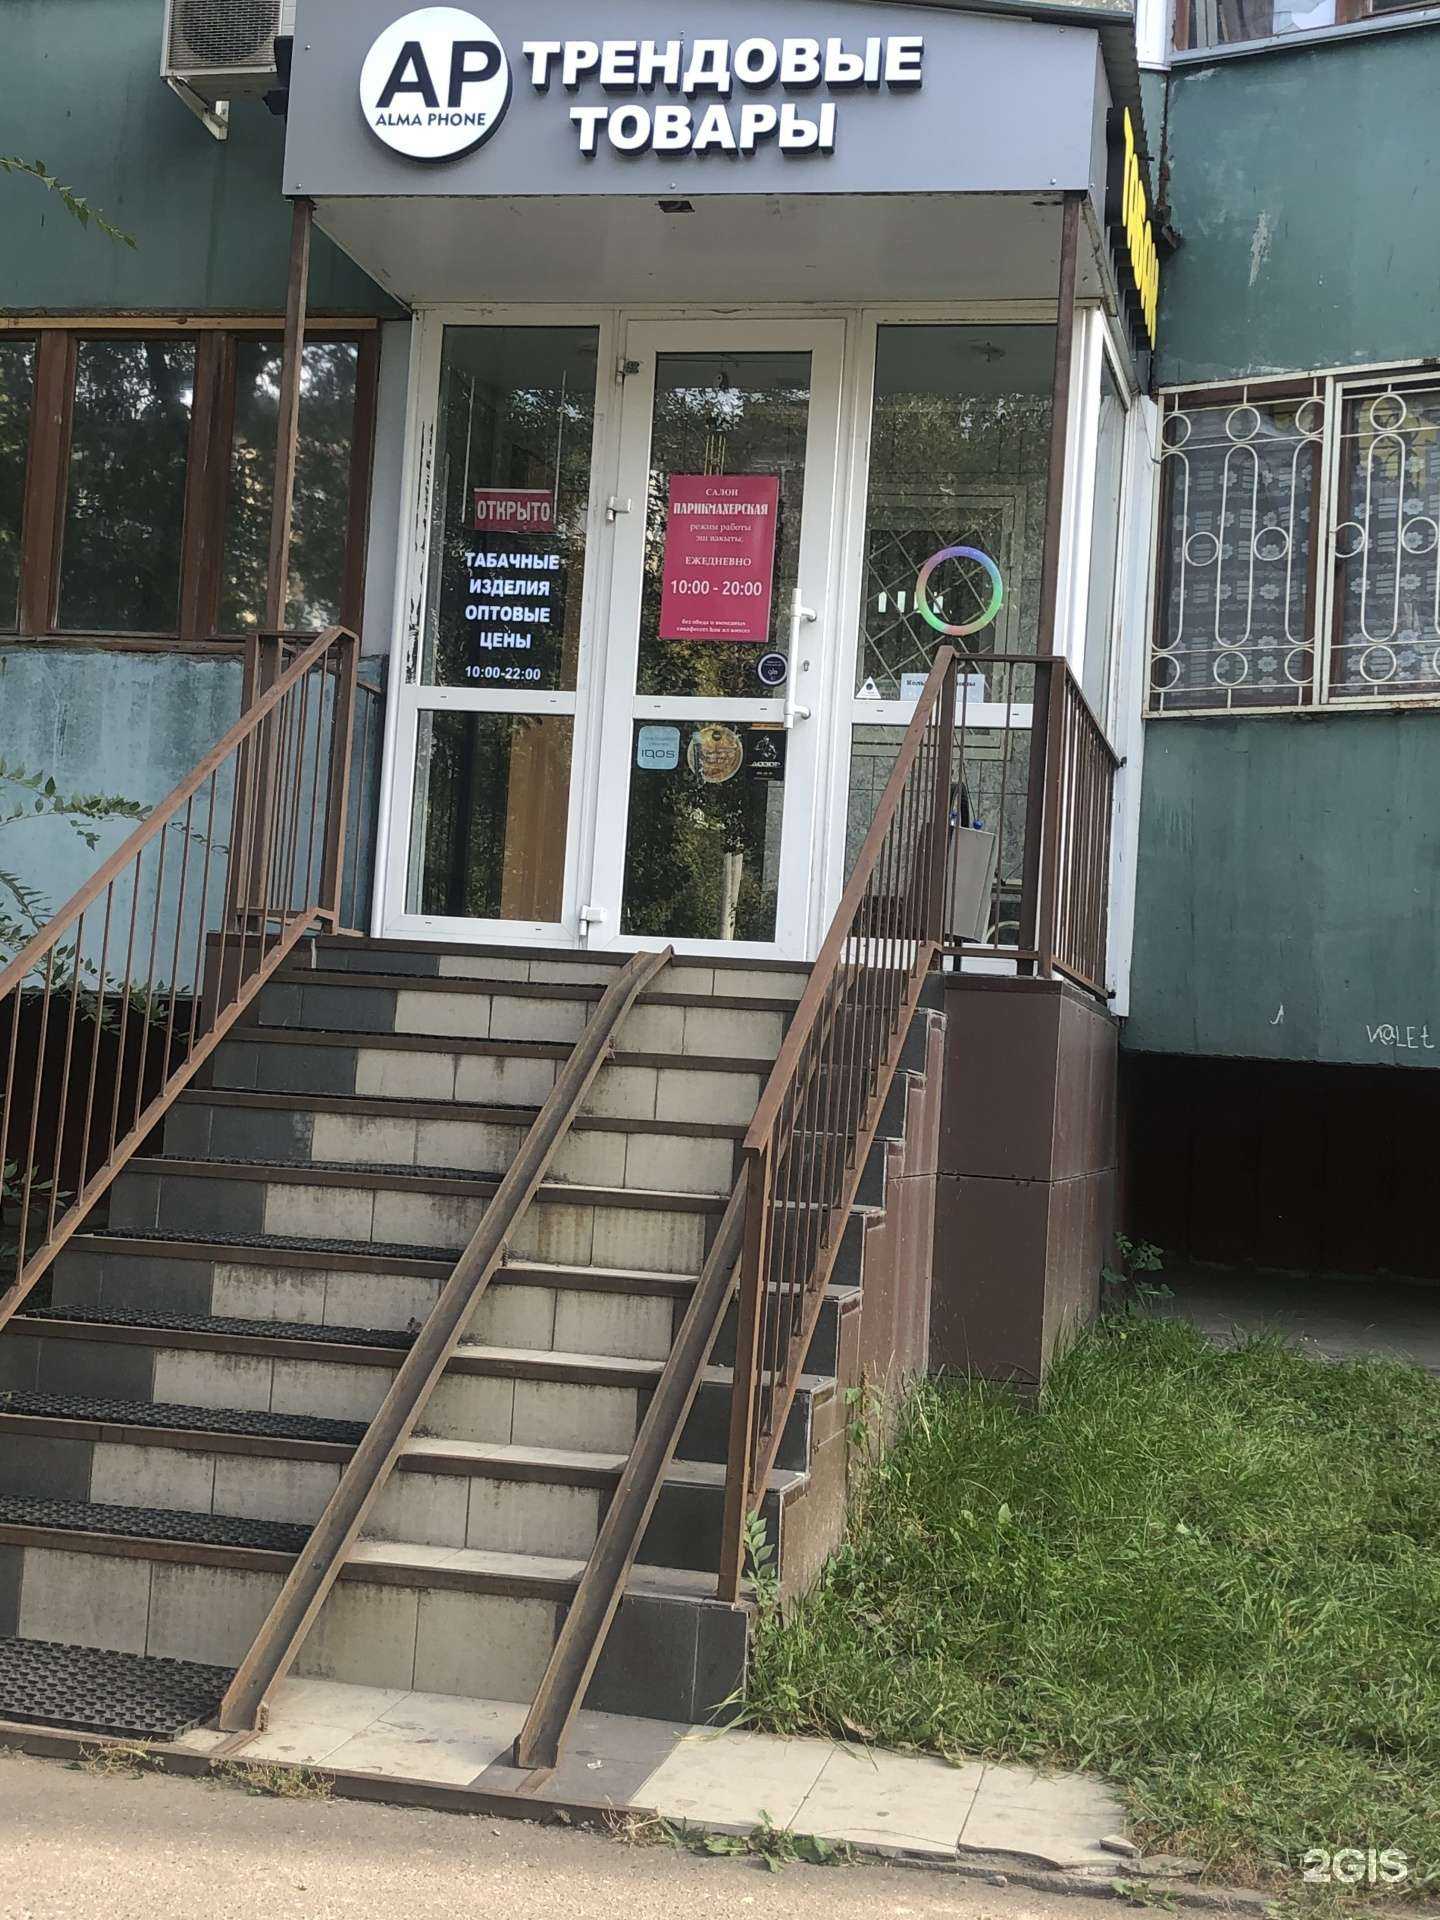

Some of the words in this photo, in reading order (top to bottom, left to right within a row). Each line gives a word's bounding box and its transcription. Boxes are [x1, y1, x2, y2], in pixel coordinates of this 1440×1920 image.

[375, 40, 502, 109] AP
[522, 36, 925, 95] ТРЕНДОВЫЕ
[375, 112, 423, 127] ALMA
[427, 111, 486, 127] PHONE
[569, 102, 838, 153] ТОВАРЫ
[705, 488, 738, 497] САЛОН
[476, 499, 550, 522] ОТКРЫТО
[673, 502, 769, 515] ПАРИКМАХЕРСКАЯ
[464, 552, 560, 570] ТАБАЧНЫЕ
[685, 556, 752, 567] ЕЖЕДНЕВНО
[468, 578, 550, 597] ИЗДЕЛИЯ
[670, 580, 710, 595] 10:00
[722, 581, 763, 596] 20:00
[465, 605, 551, 623] ОПТОВЫЕ
[479, 631, 531, 650] ЦЕНЫ
[465, 665, 541, 681] 10:00-22:00
